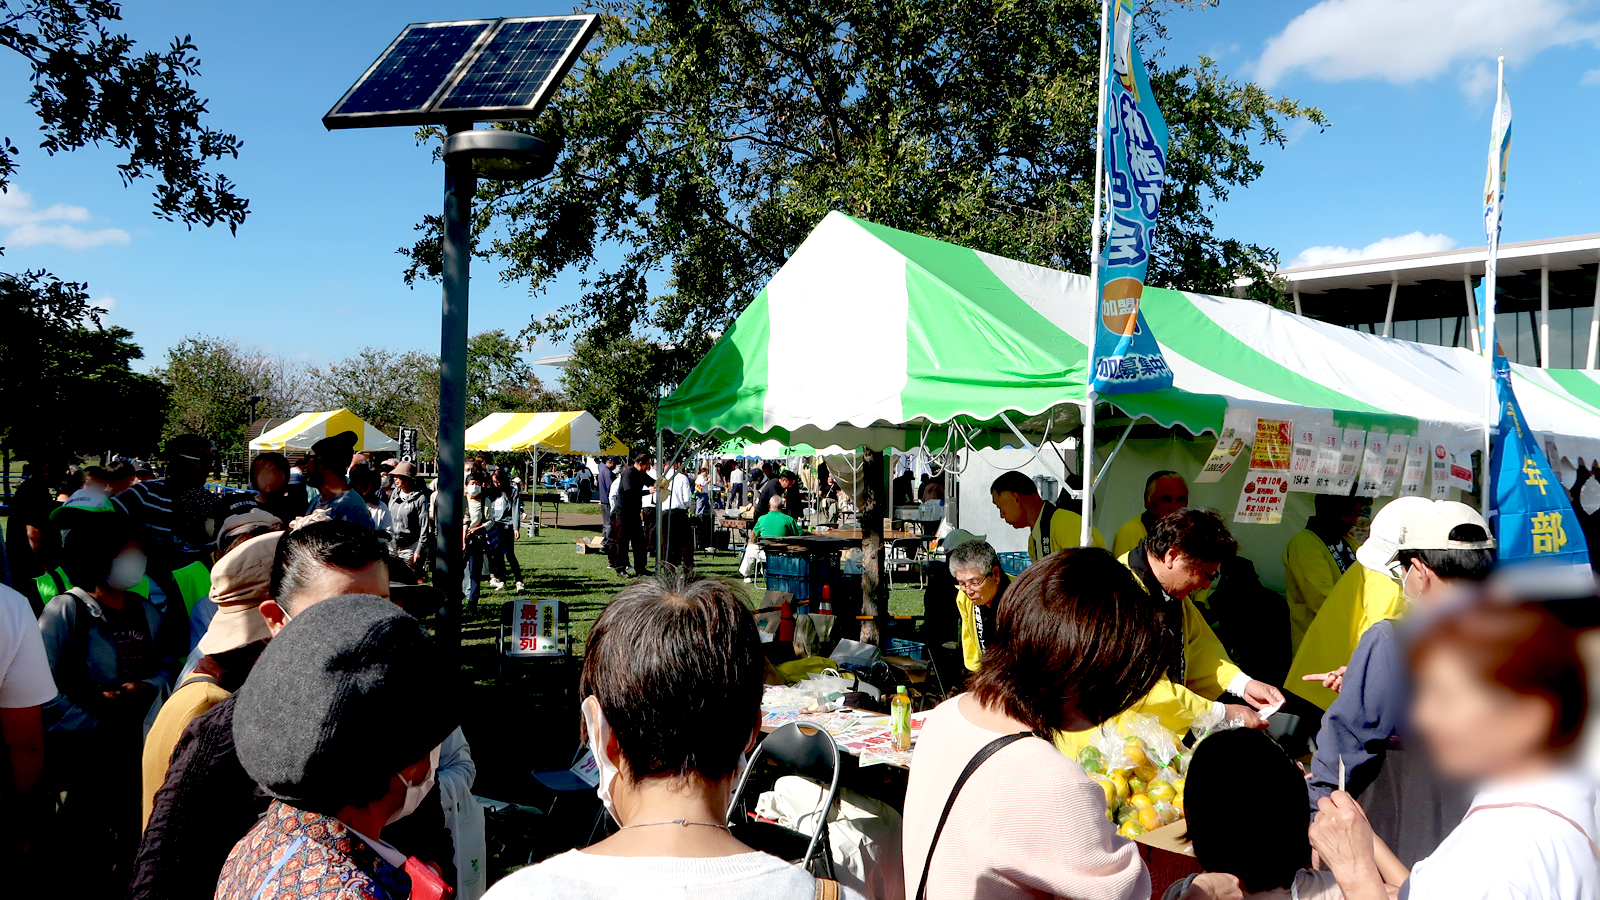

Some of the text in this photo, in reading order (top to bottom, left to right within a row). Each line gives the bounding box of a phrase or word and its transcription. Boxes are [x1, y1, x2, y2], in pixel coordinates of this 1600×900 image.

[1102, 297, 1140, 317] 加盟
[519, 604, 539, 651] 最前列
